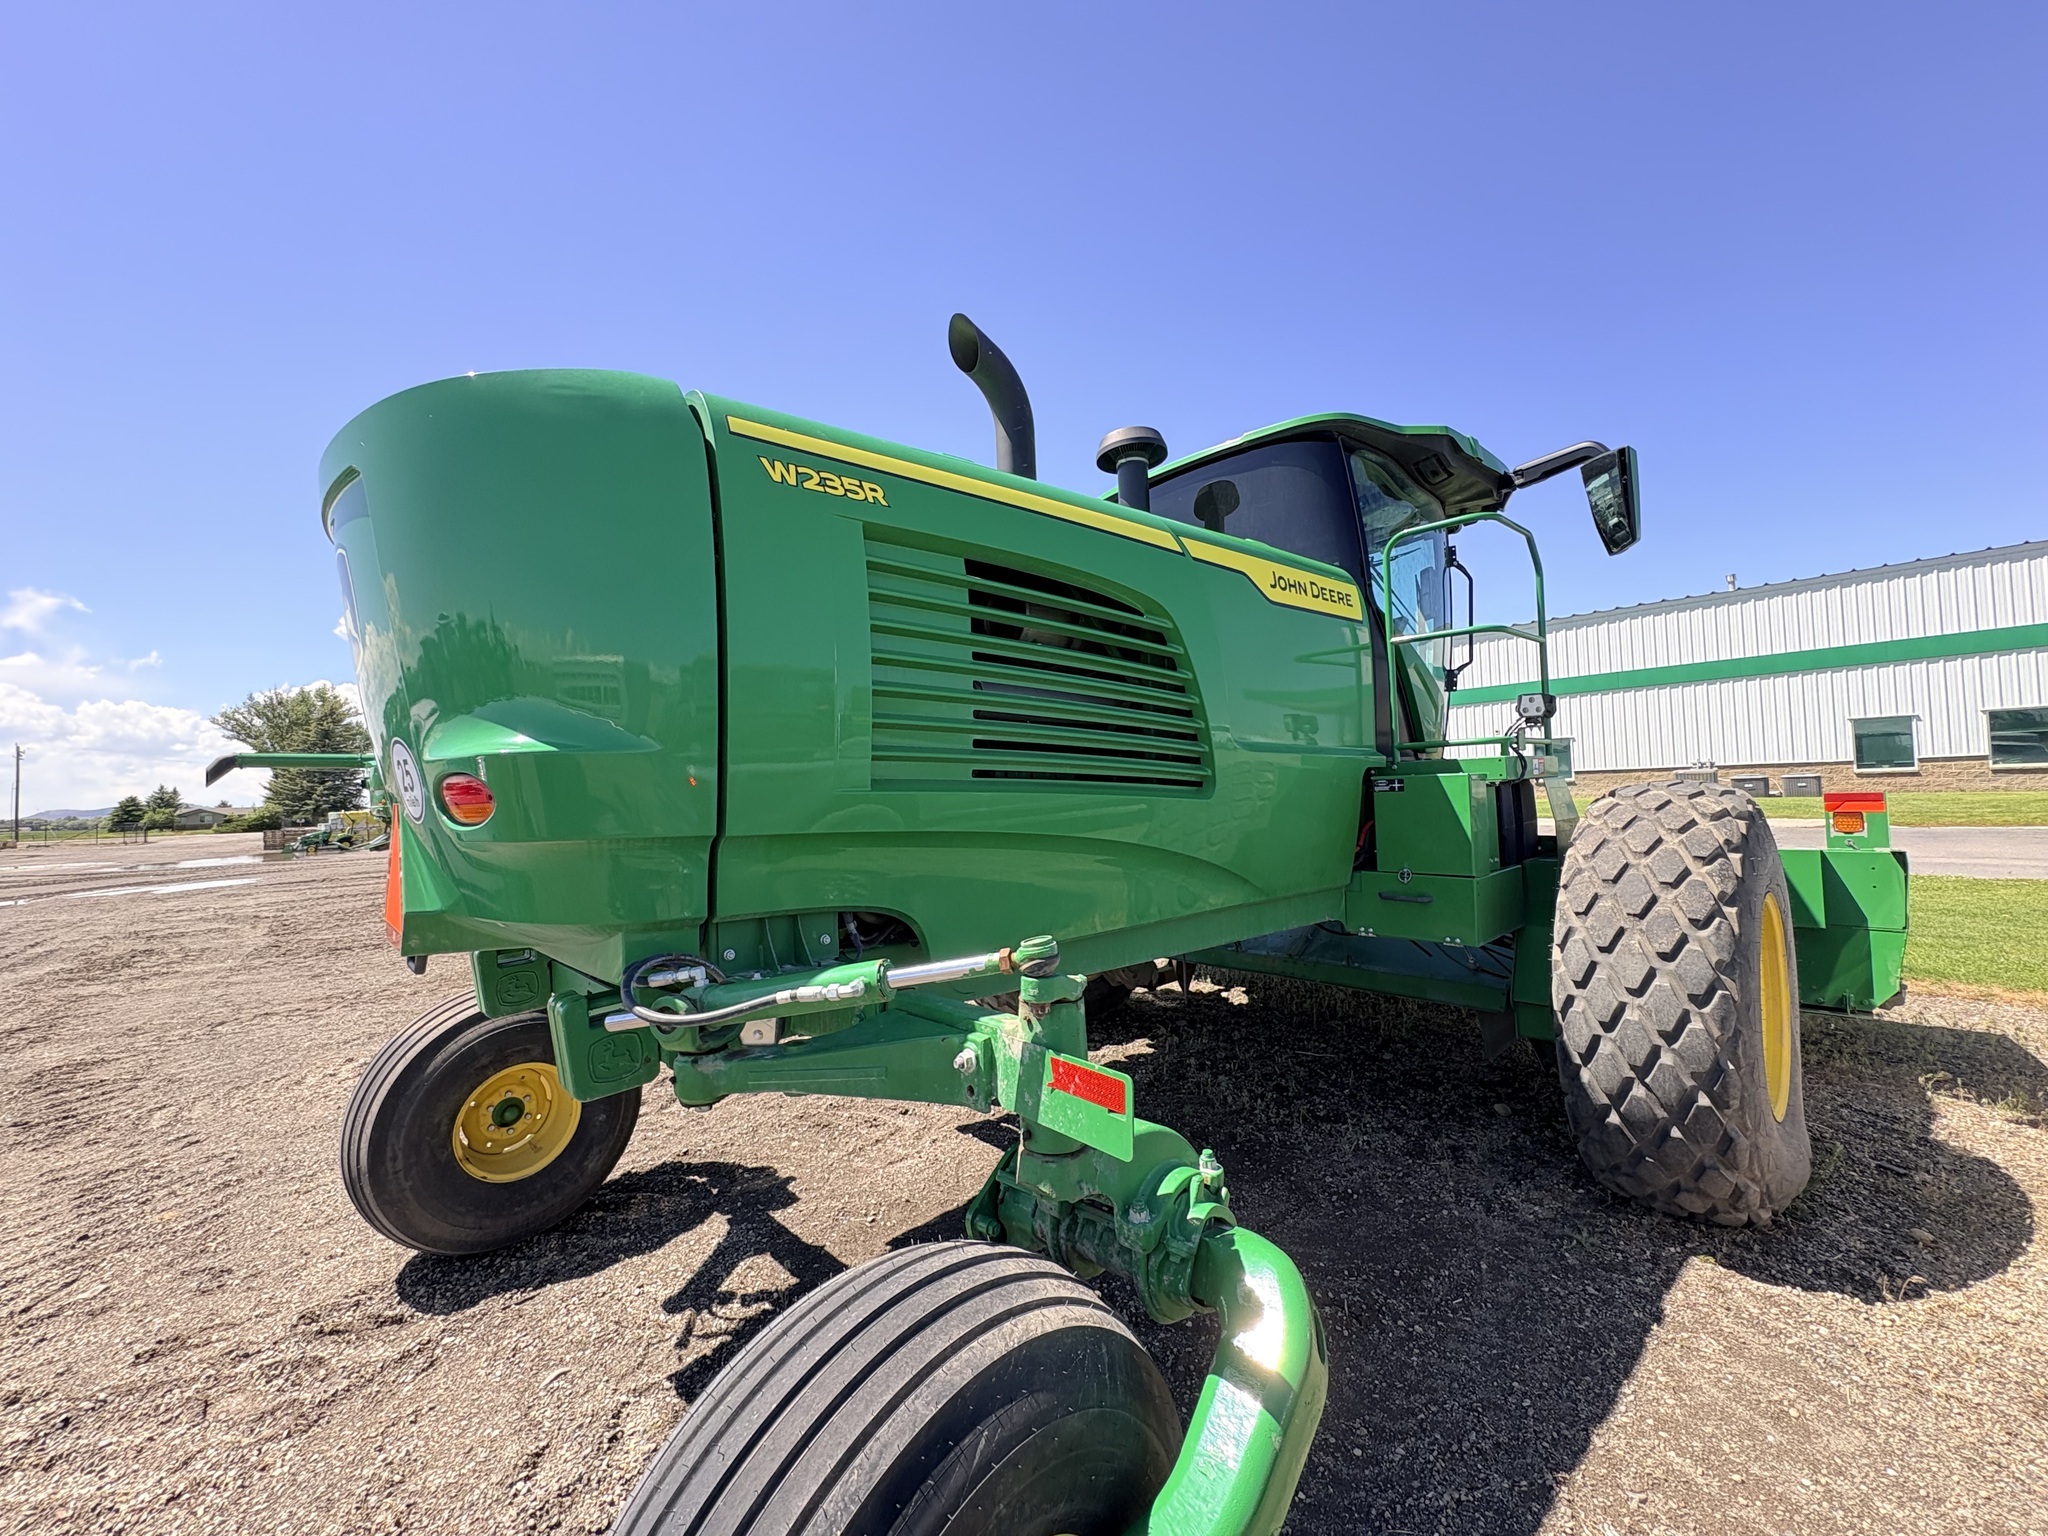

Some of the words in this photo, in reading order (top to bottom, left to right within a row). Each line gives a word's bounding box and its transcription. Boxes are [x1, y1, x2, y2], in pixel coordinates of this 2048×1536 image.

[757, 455, 891, 508] W235R
[1270, 571, 1308, 596] JOHN
[1309, 581, 1354, 608] DEERE
[397, 759, 415, 793] 25
